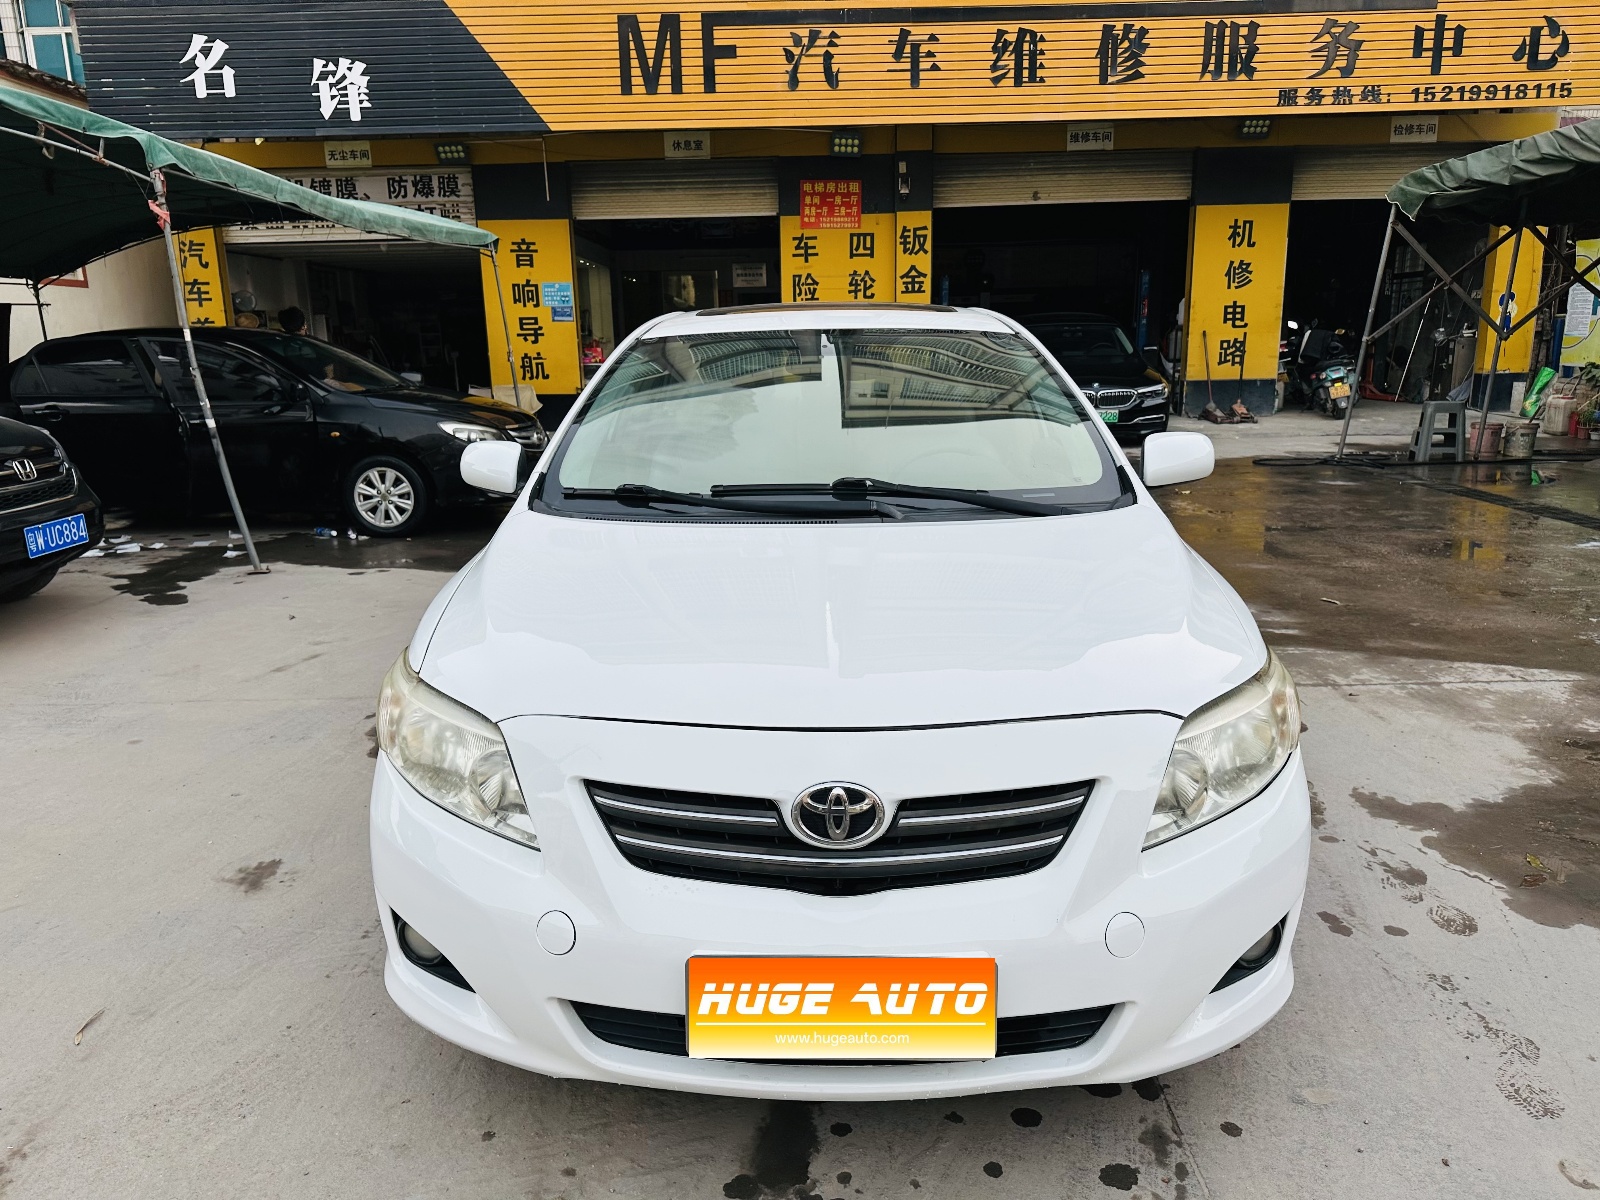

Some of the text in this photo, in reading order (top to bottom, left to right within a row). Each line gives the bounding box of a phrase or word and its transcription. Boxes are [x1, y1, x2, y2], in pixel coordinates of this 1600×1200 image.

[617, 13, 738, 96] MF
[782, 15, 1570, 92] 汽车维修服务中心
[179, 33, 372, 122] 名锋
[1411, 82, 1573, 103] 15219918115
[671, 139, 704, 153] 休息室
[1069, 131, 1113, 145] 维修车间
[1393, 122, 1437, 136] 检修车间
[327, 148, 371, 162] 无尘车间
[803, 182, 860, 193] 电梯房出租
[804, 195, 858, 205] 单间 一房一厅
[804, 206, 858, 217] 两房一厅 三房一厅
[791, 232, 820, 302] 车险
[848, 232, 876, 300] 四轮
[899, 225, 929, 294] 钣金
[509, 238, 550, 381] 音响导航
[1217, 218, 1256, 366] 机修电路
